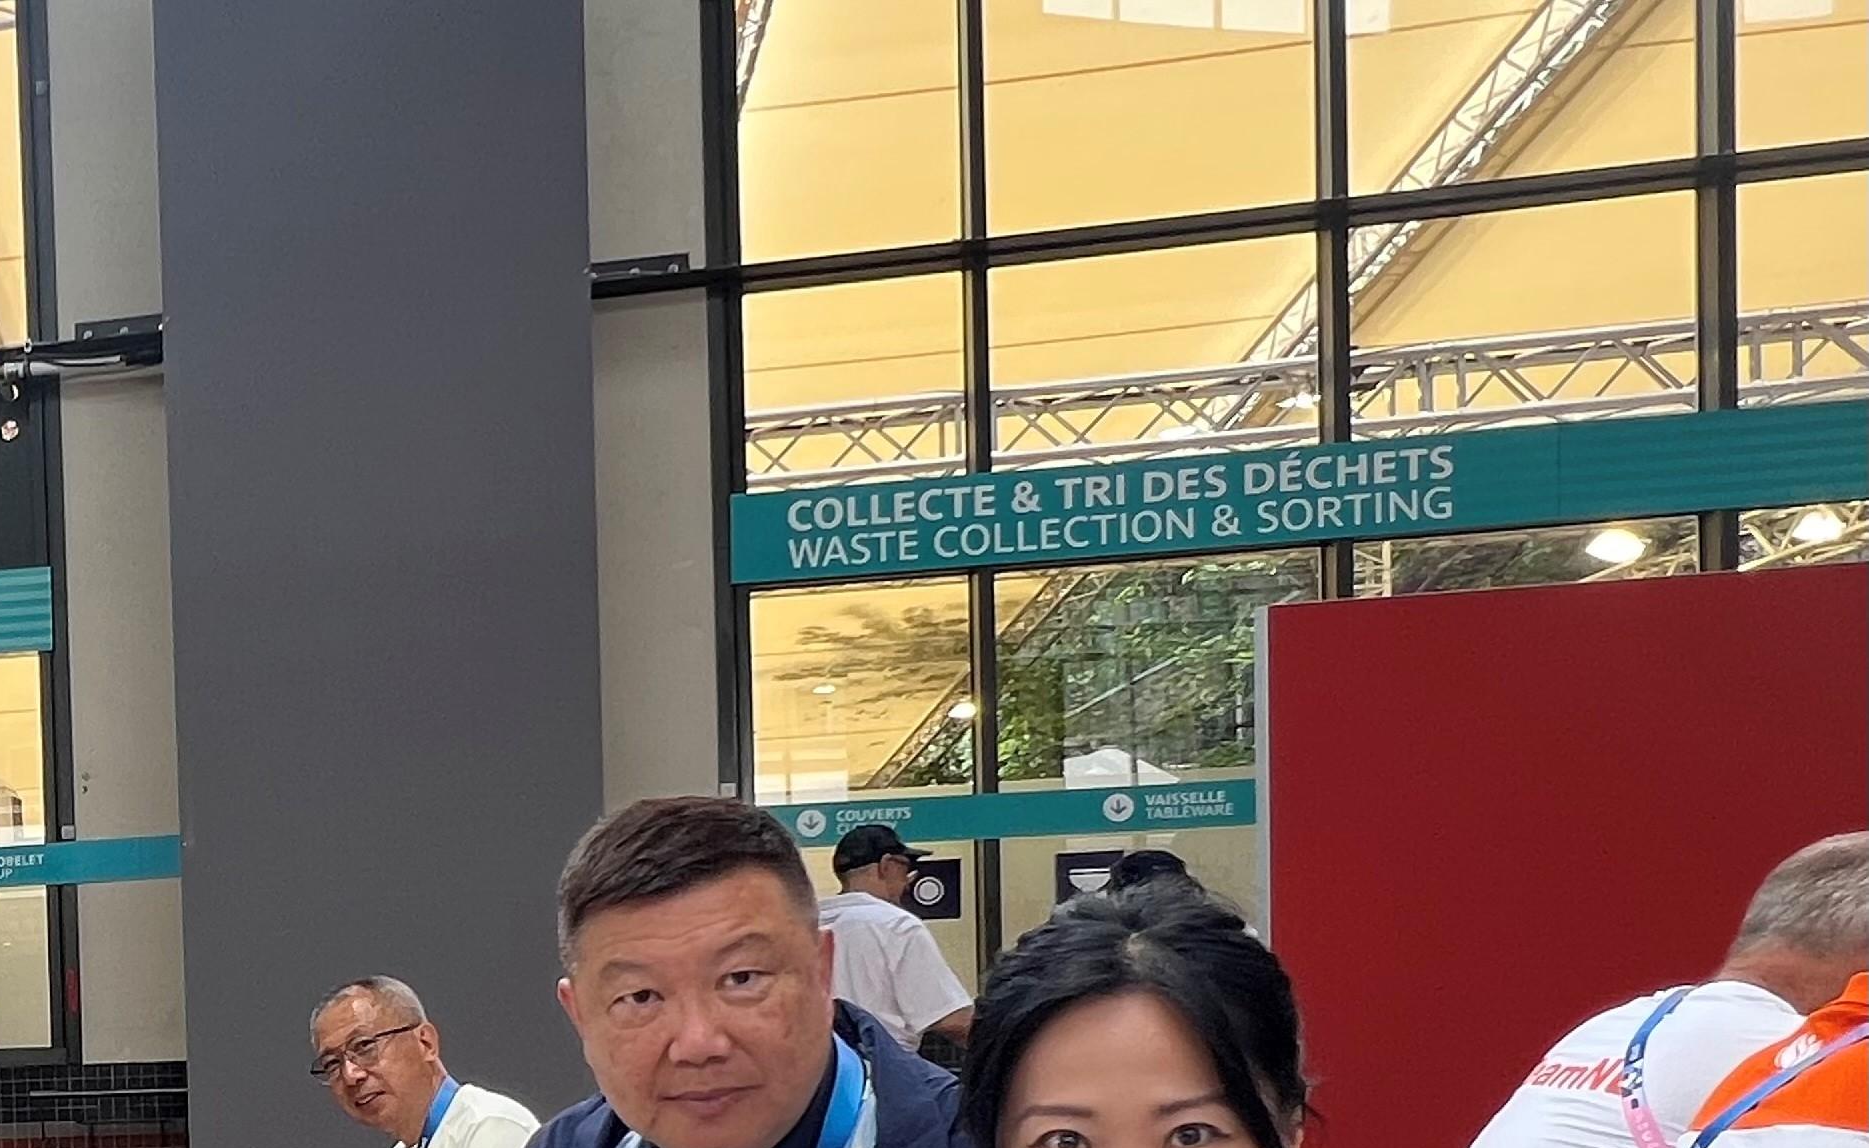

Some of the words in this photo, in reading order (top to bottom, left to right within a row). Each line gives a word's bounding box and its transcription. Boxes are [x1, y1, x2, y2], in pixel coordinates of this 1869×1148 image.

[787, 484, 996, 532] COLLECTE
[1011, 480, 1043, 514] &
[1054, 473, 1125, 510] TRI
[1143, 465, 1227, 503] DES
[1244, 445, 1454, 495] DÉCHETS
[788, 529, 919, 569] WASTE
[933, 507, 1195, 558] COLLECTION
[1211, 504, 1242, 537] &
[1257, 486, 1453, 534] SORTING
[1144, 790, 1226, 805] VAISSELLE
[836, 806, 912, 822] COUVERTS
[1145, 802, 1234, 819] TABLEWARE
